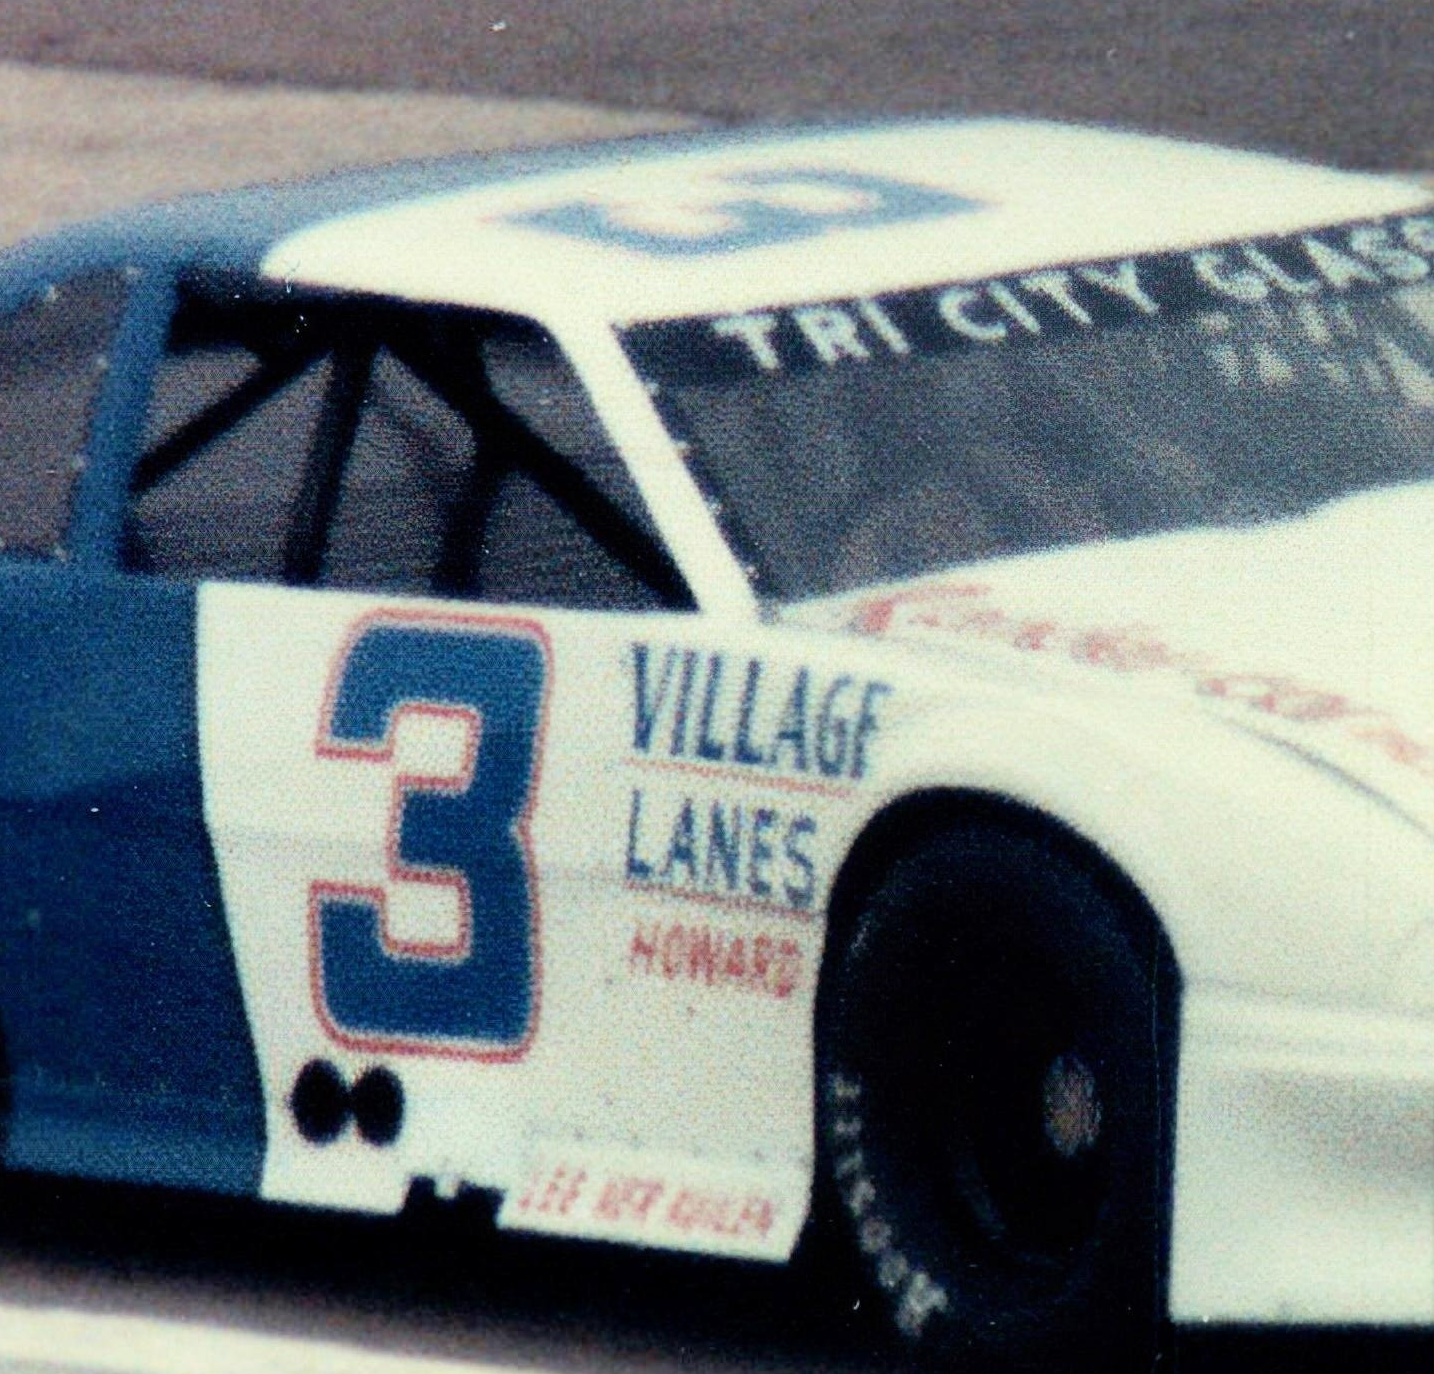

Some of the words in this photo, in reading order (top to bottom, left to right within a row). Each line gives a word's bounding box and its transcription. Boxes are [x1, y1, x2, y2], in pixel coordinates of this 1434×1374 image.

[712, 295, 912, 371] TRI
[938, 255, 1160, 343] CITY
[308, 605, 554, 1065] 3
[622, 785, 818, 911] LANES
